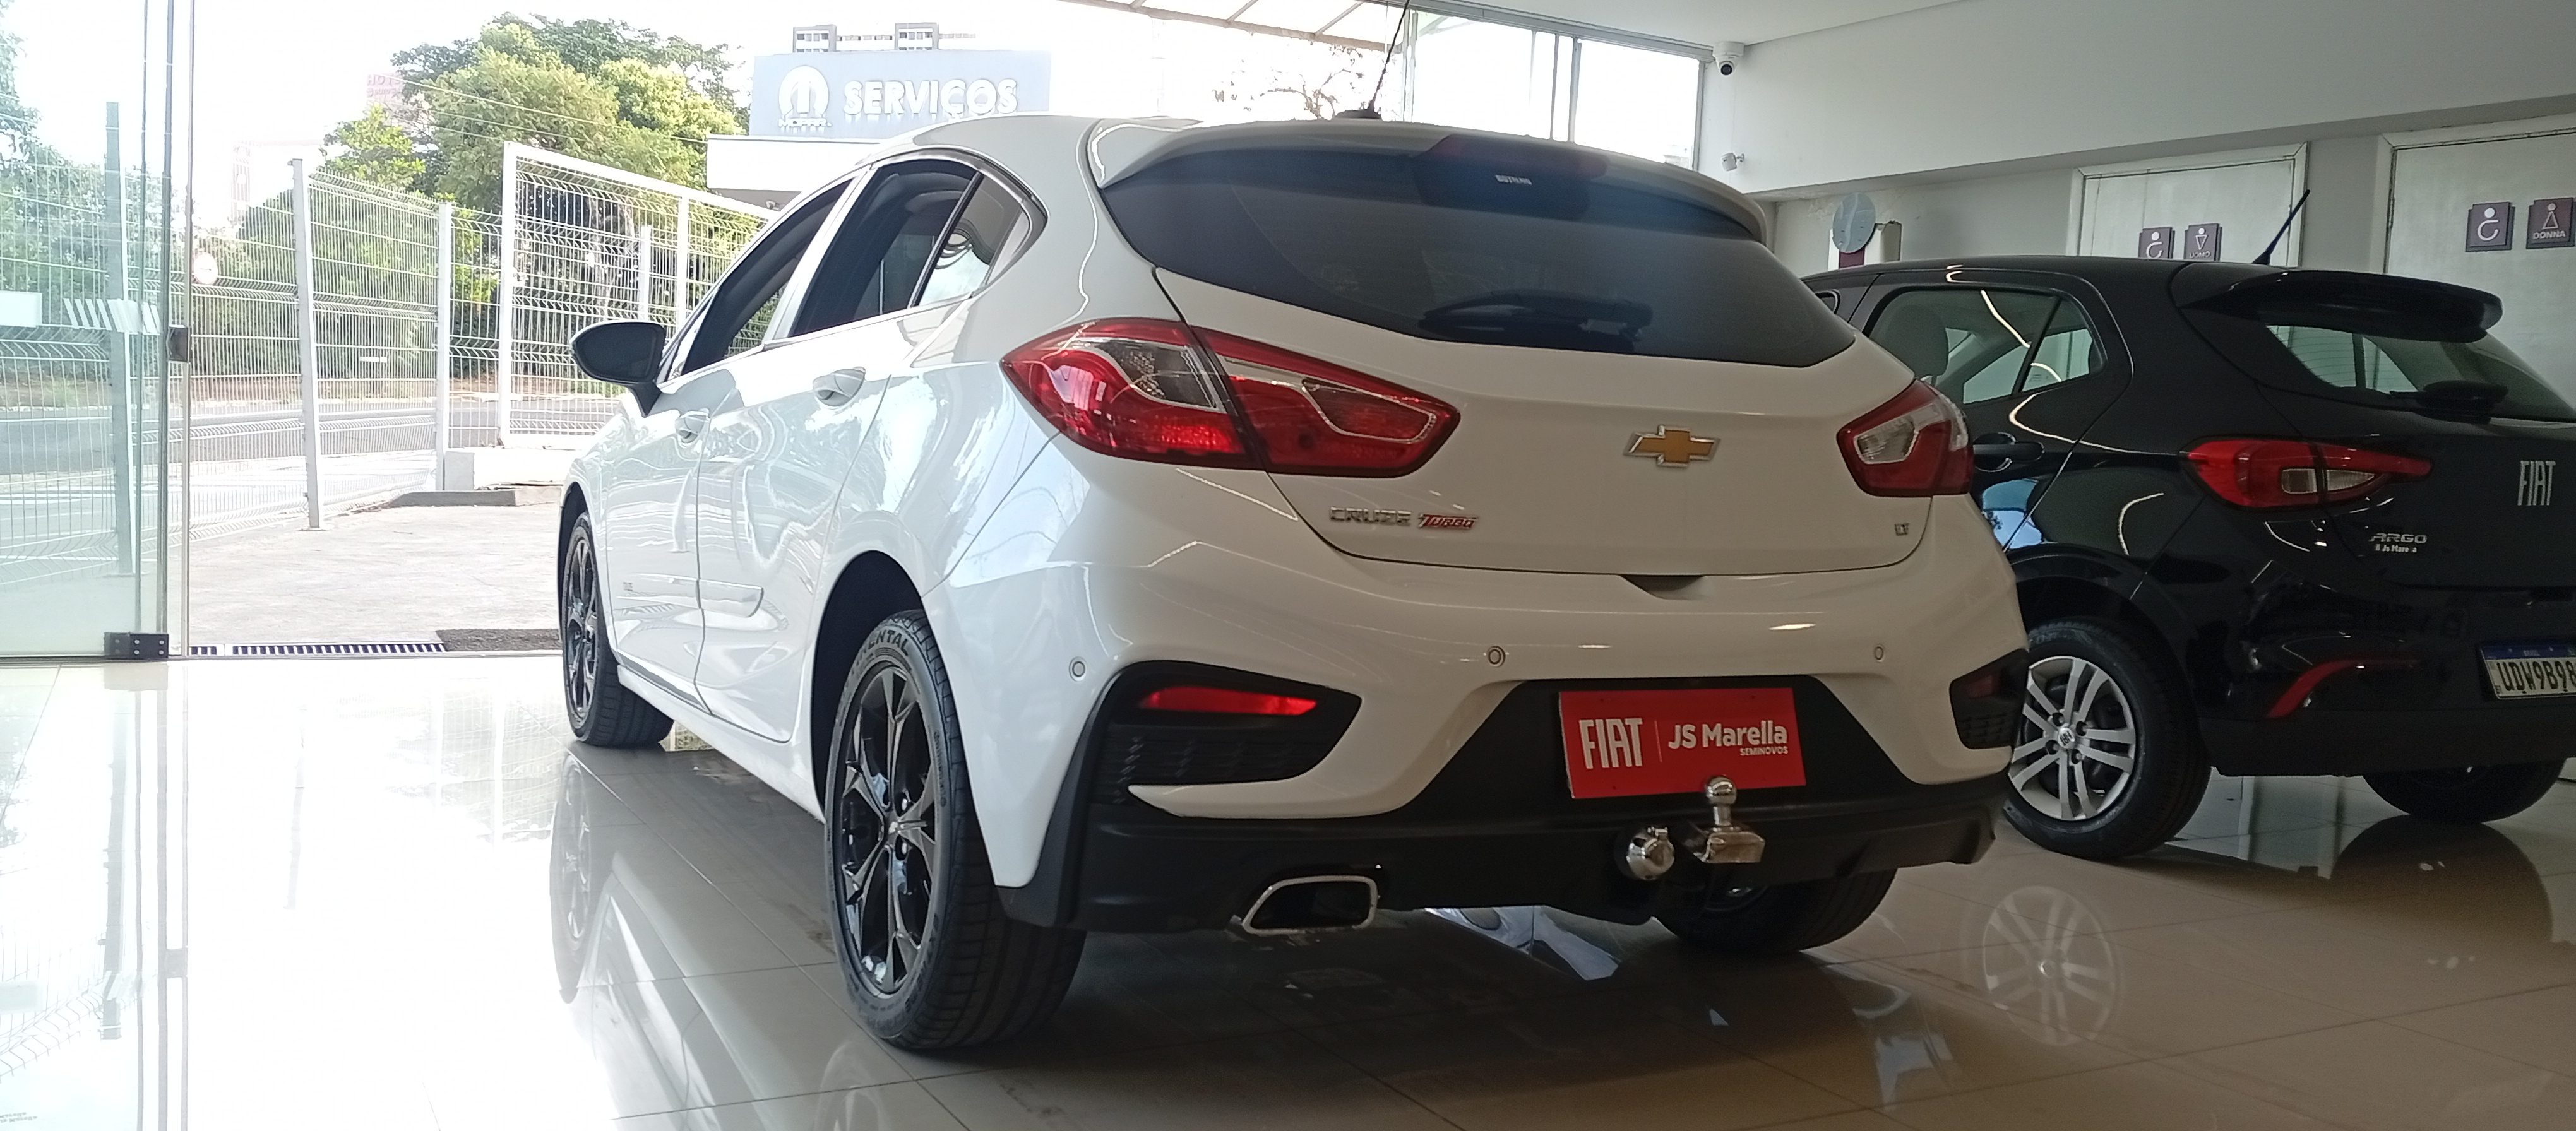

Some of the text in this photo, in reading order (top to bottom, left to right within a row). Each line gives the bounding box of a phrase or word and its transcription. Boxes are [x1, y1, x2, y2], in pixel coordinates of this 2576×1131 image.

[2533, 231, 2566, 239] DONNA
[2517, 461, 2556, 506] FIAT
[1330, 507, 1412, 526] CRUZE
[2368, 533, 2428, 543] ARGO
[1579, 718, 1788, 769] FIAT JS Marella
[1739, 746, 1789, 756] SEMINOVOS
